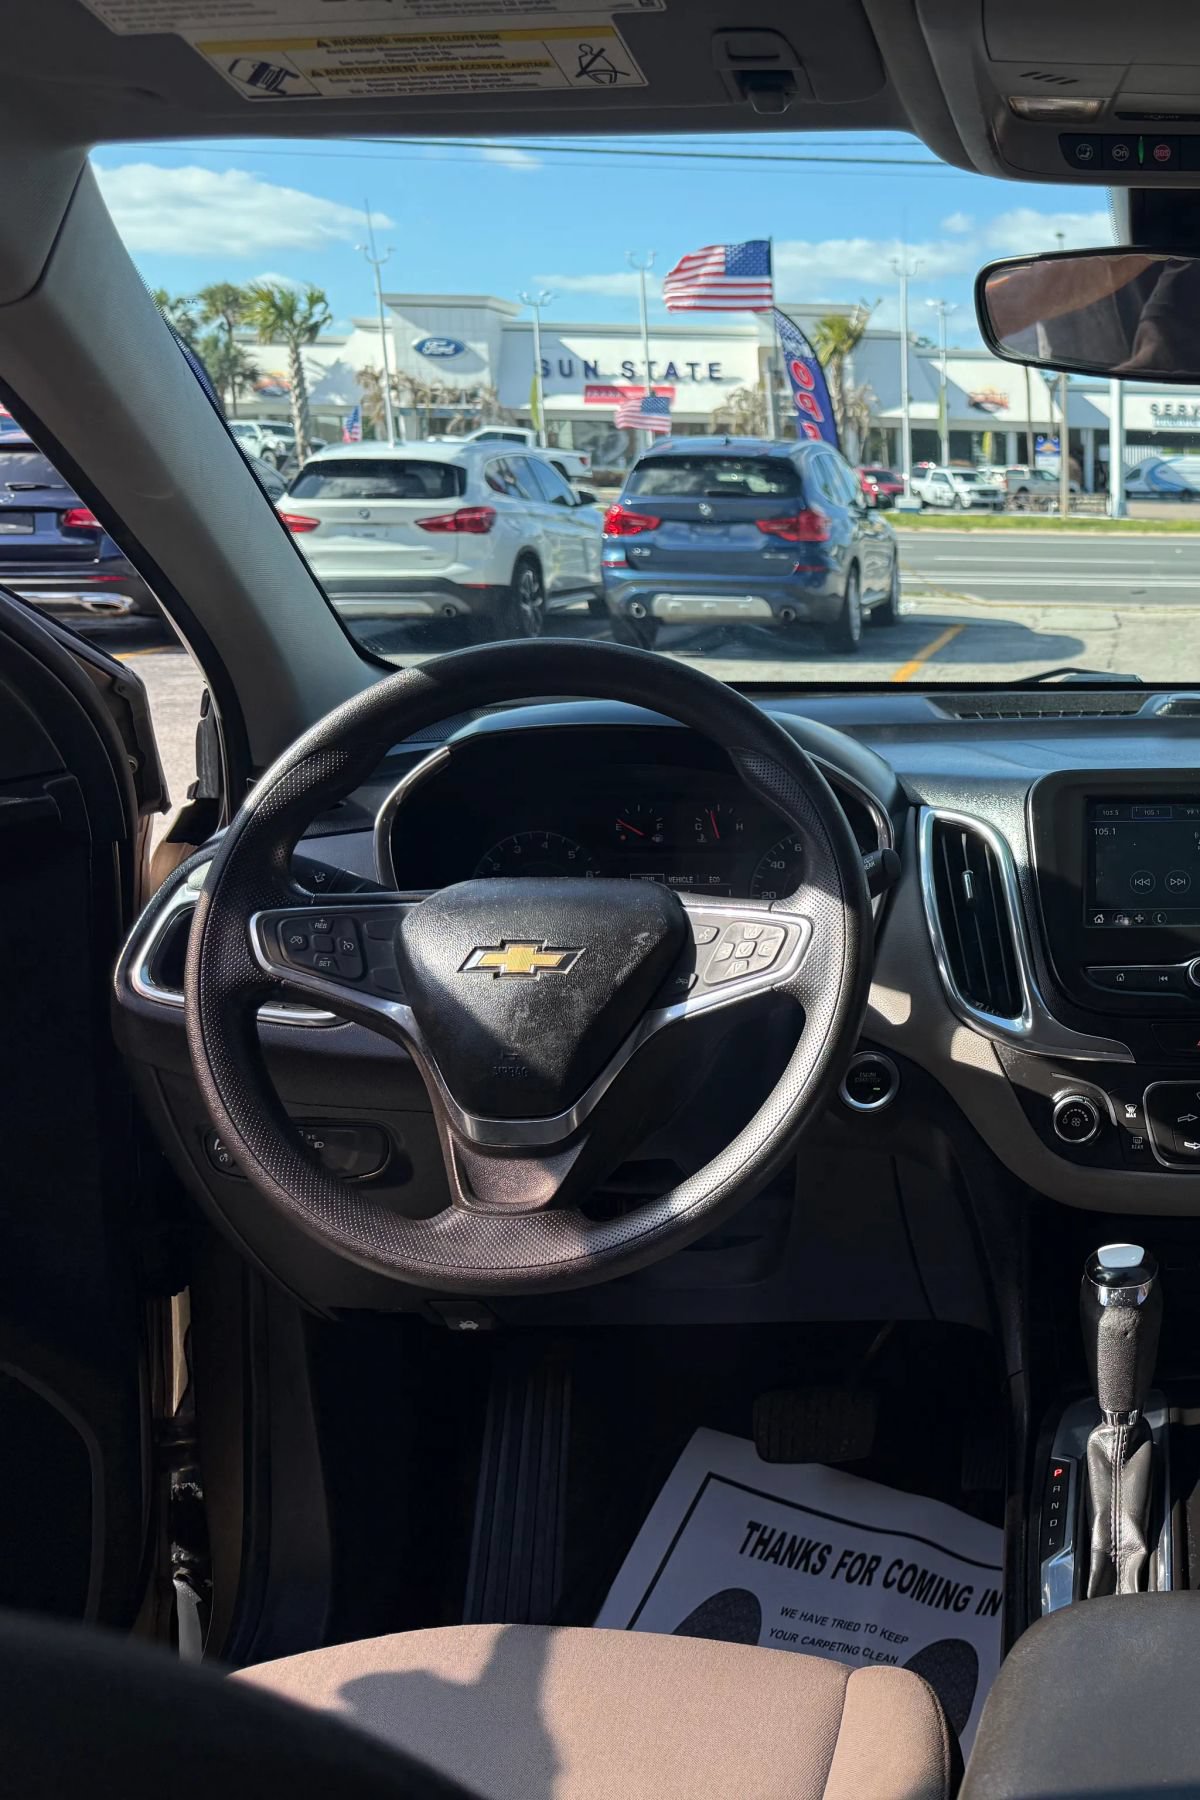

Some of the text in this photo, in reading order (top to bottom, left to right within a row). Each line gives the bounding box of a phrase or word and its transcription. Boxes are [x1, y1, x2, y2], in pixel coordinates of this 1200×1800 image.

[540, 358, 724, 382] SUN STATE
[615, 823, 622, 831] E
[656, 823, 663, 831] F
[695, 823, 703, 831] C
[735, 823, 744, 831] H
[1094, 827, 1116, 836] 105.1
[540, 840, 549, 850] 4
[512, 845, 522, 855] 3
[567, 850, 576, 860] 5
[492, 862, 502, 871] 2
[770, 861, 785, 870] 40
[585, 869, 593, 878] 6
[668, 876, 694, 884] VEHICLE
[760, 891, 777, 900] 20
[1053, 1468, 1063, 1477] P
[1052, 1485, 1061, 1494] R
[1050, 1501, 1060, 1510] N
[1049, 1518, 1058, 1527] D
[1048, 1536, 1055, 1545] L
[739, 1520, 1004, 1618] THANKS FOR COMING IN
[780, 1606, 910, 1645] WE HAVE TRIED TO KEEP
[768, 1628, 899, 1666] YOUR CARPETING CLEAN
